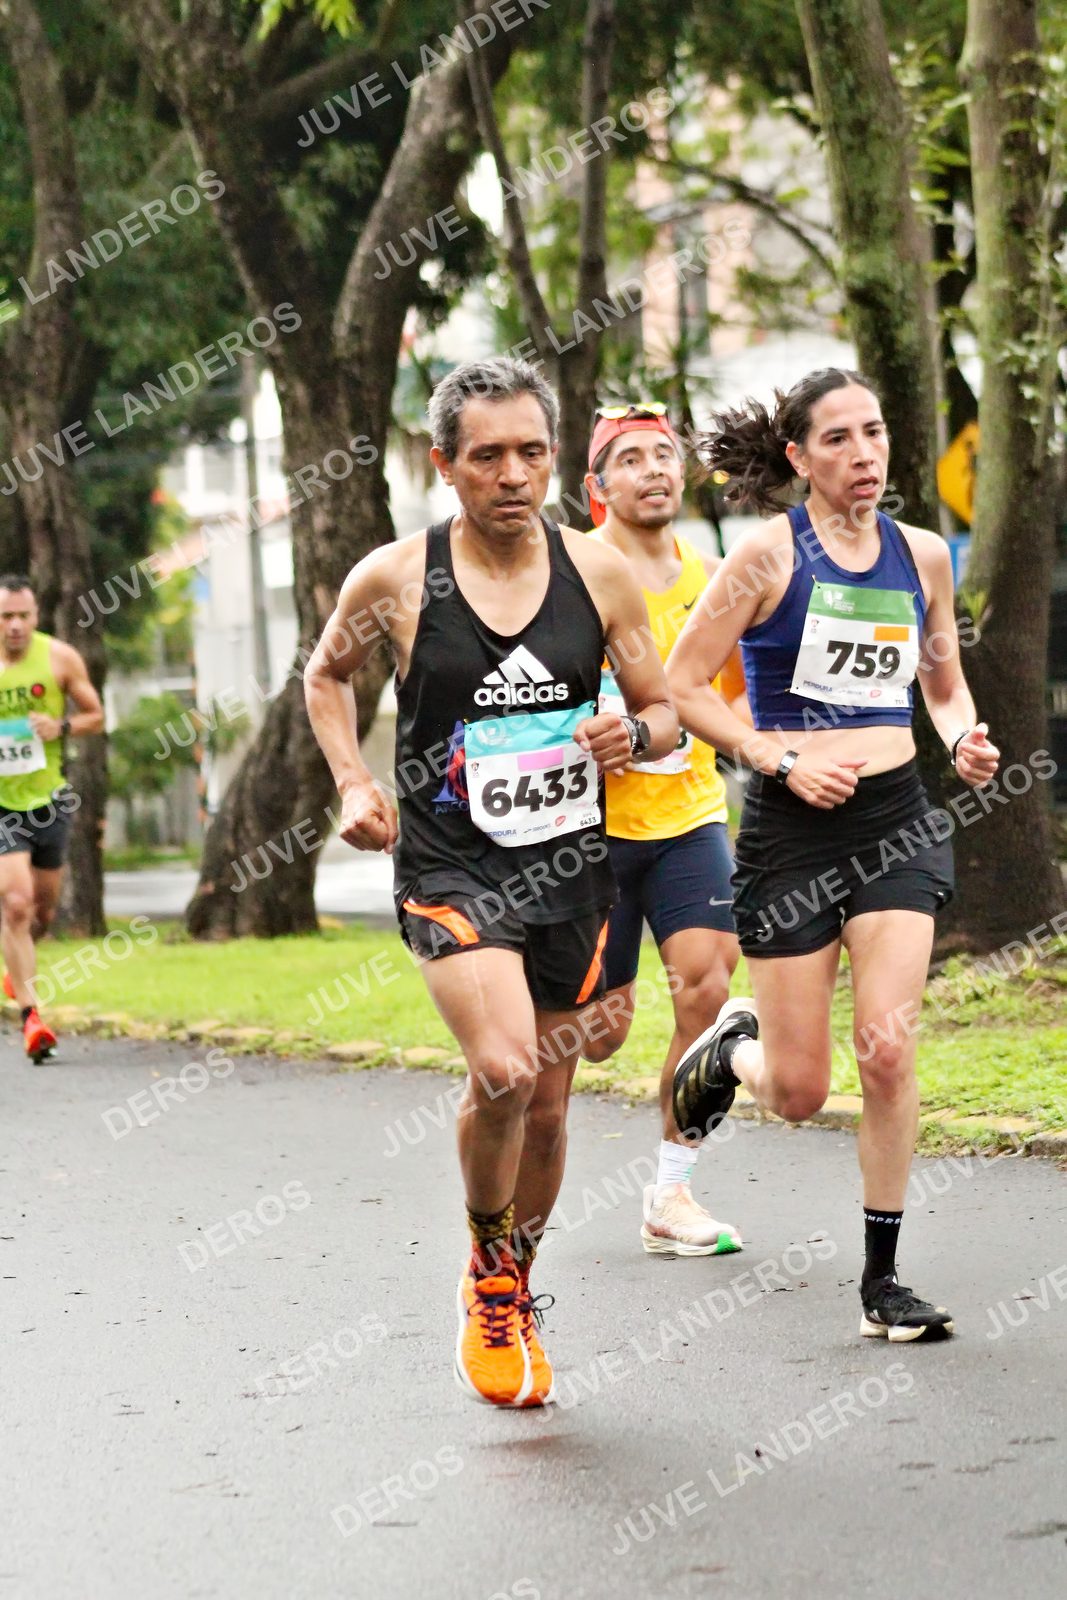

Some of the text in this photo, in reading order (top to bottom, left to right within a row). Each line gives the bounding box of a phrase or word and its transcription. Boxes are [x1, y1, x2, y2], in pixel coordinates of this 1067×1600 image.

[826, 640, 901, 680] 759
[474, 682, 568, 707] adidas
[482, 761, 587, 818] 6433
[580, 817, 597, 827] 6433
